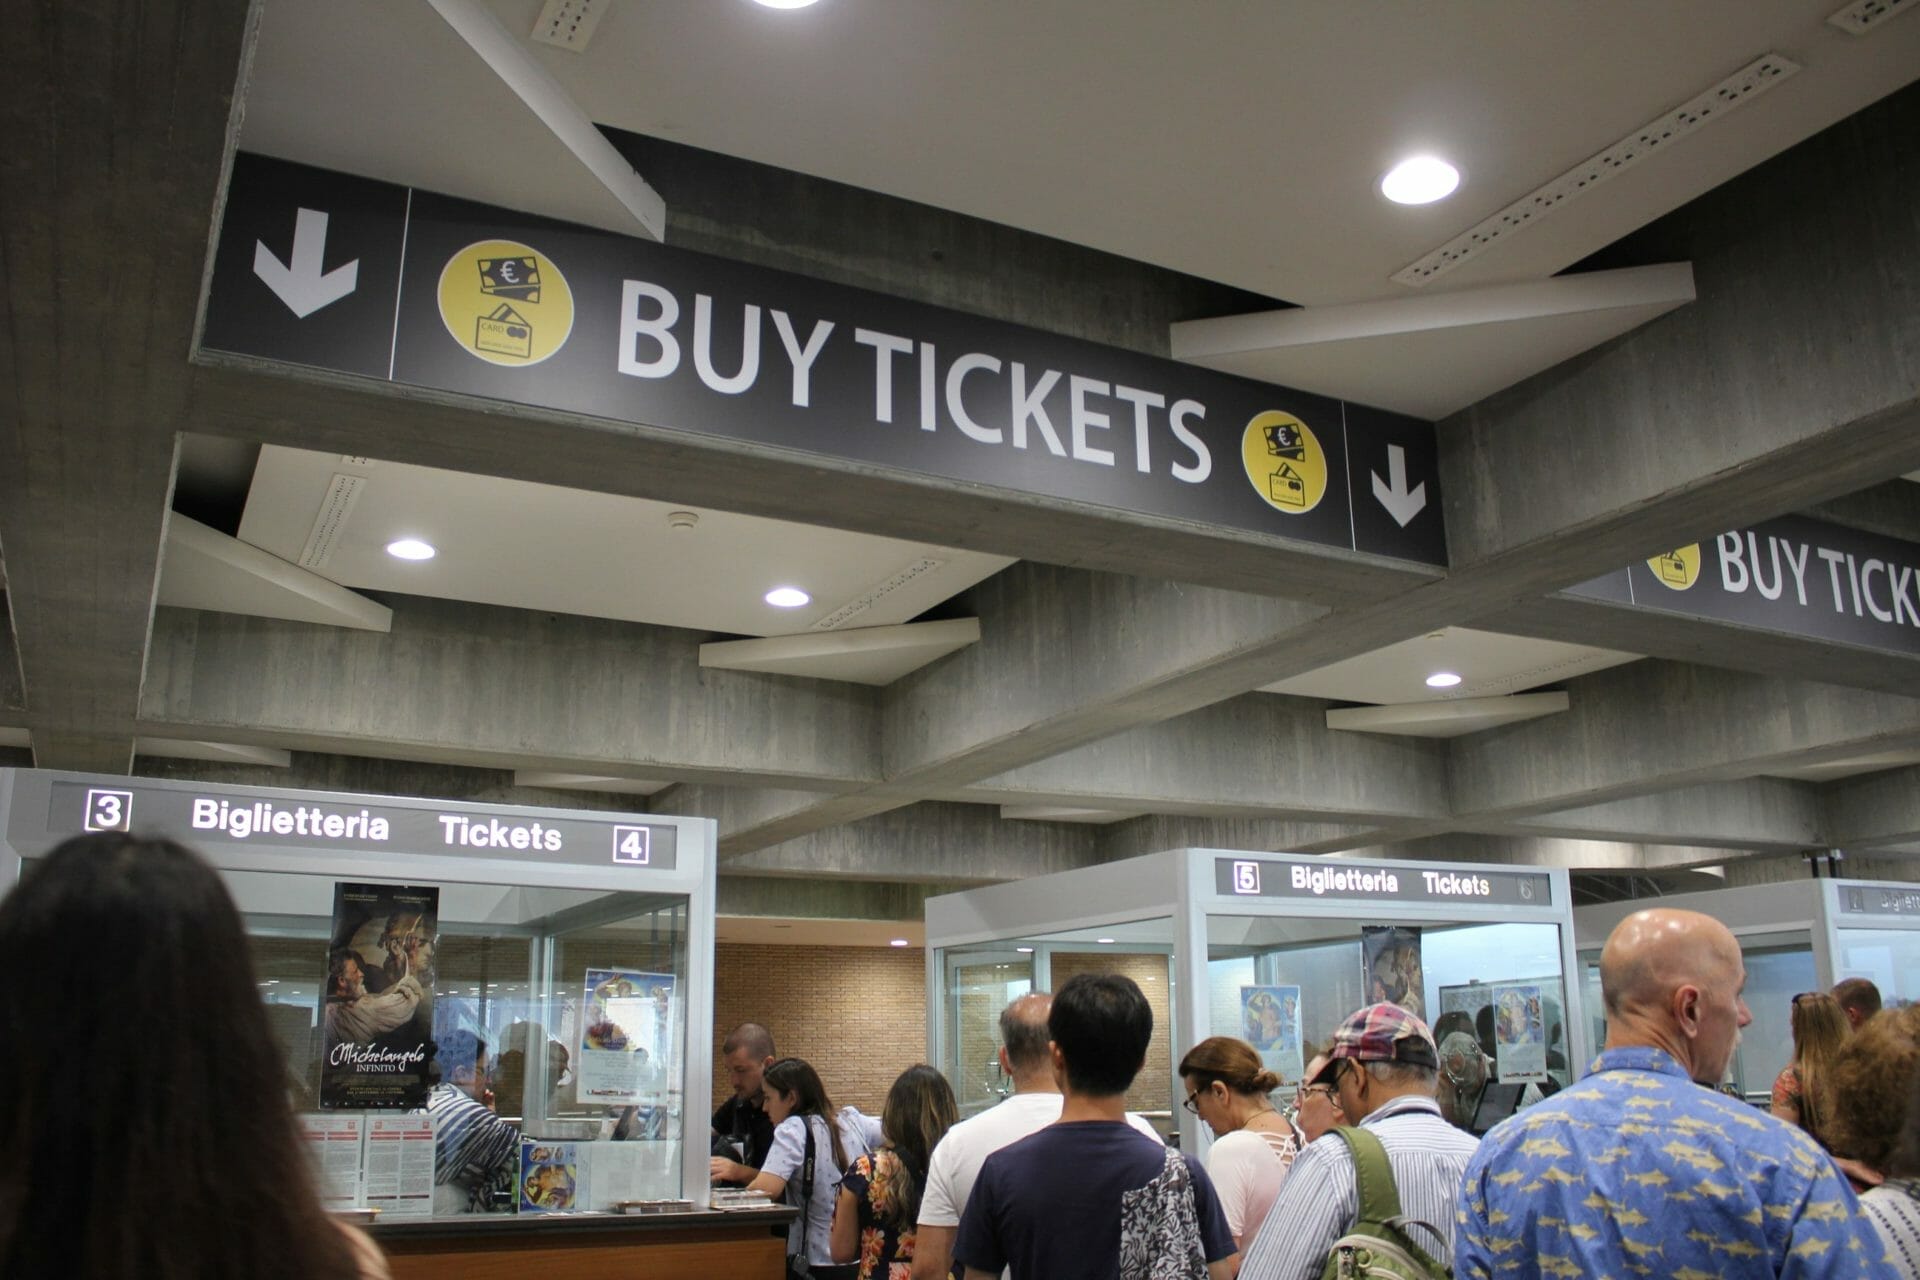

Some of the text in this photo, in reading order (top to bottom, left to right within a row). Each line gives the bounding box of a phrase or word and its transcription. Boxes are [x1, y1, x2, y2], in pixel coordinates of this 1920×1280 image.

[481, 322, 505, 333] CARD
[618, 279, 1212, 483] BUY TICKETS
[1717, 530, 1920, 628] BUY TICK
[95, 795, 642, 859] 3 Biglietteria Tickets 4
[1239, 865, 1255, 890] 5
[1291, 865, 1399, 895] Biglietteria
[1422, 871, 1490, 896] Tickets
[330, 1042, 425, 1072] Michelangelo
[356, 1064, 396, 1073] INFINITO
